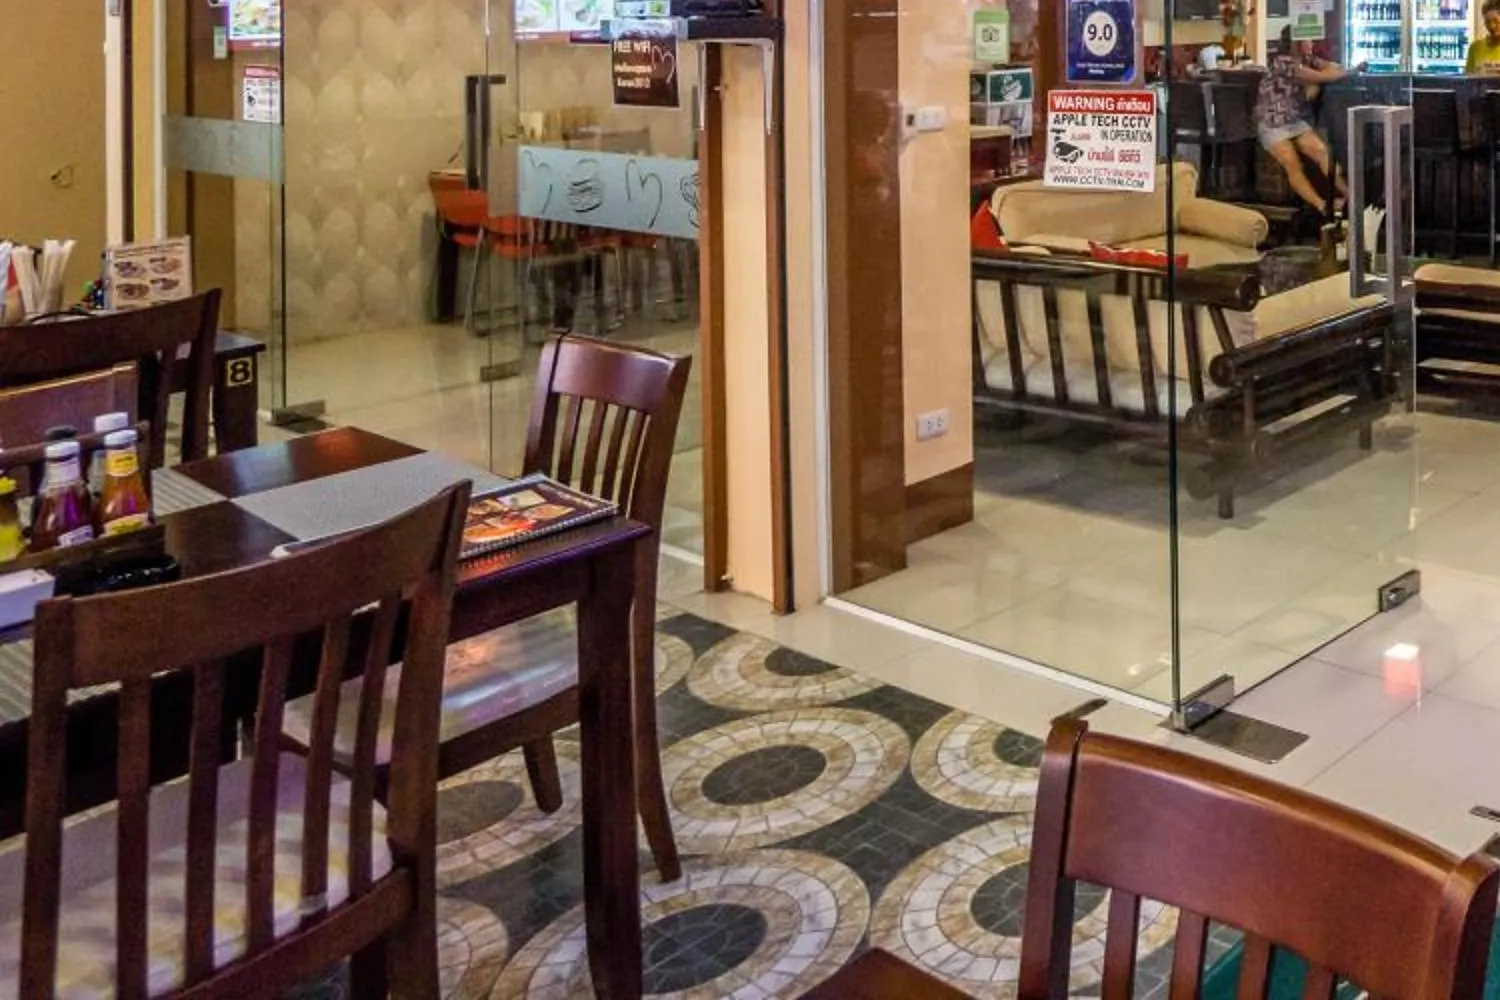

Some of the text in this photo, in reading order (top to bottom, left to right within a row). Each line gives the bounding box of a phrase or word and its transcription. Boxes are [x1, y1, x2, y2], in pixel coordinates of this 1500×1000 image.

[1087, 23, 1113, 42] 9.0
[1053, 95, 1115, 111] WARNING
[1053, 114, 1151, 129] APPLE TECH CCTV
[1110, 129, 1153, 143] OPERATION
[229, 360, 251, 384] 8
